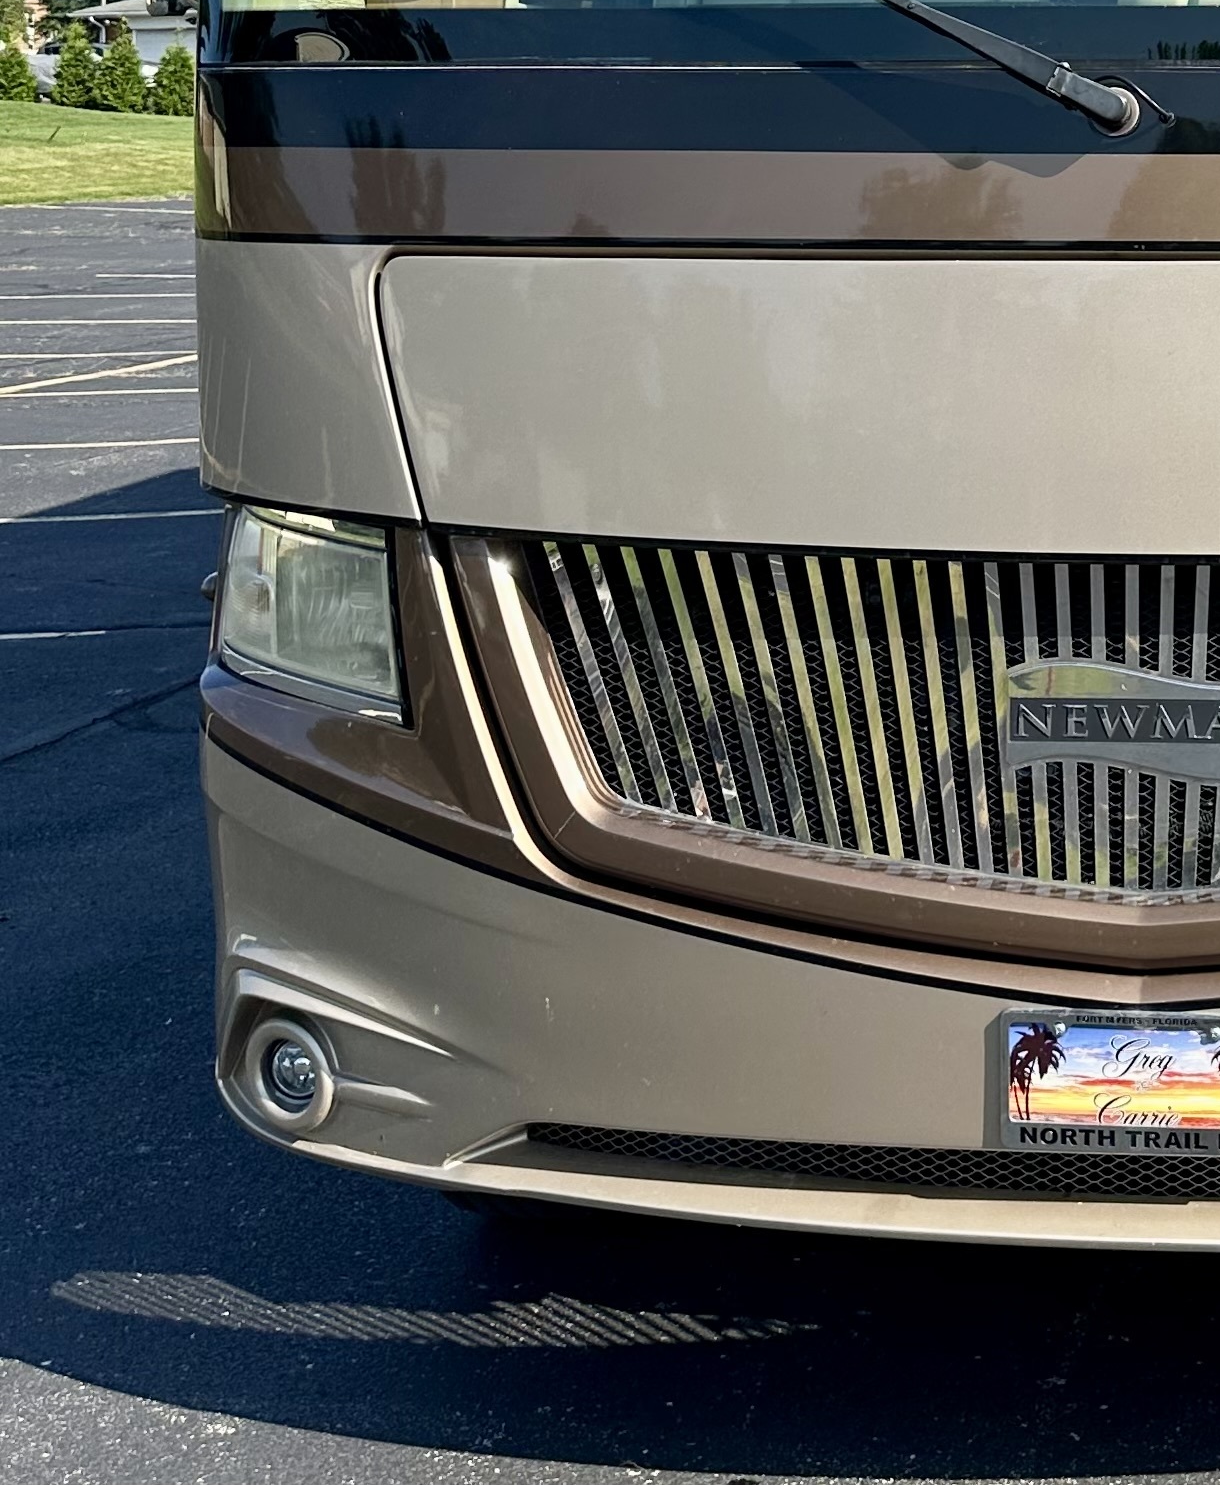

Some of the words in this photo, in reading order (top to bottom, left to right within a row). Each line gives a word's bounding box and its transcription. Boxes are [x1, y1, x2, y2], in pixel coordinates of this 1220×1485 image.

[1076, 1015, 1103, 1023] FORT
[1152, 1018, 1198, 1026] FLORIDA
[1102, 1035, 1174, 1079] Greg
[1094, 1093, 1178, 1125] Carrie
[1020, 1126, 1115, 1147] NORTH
[1125, 1131, 1208, 1149] TRAIL
